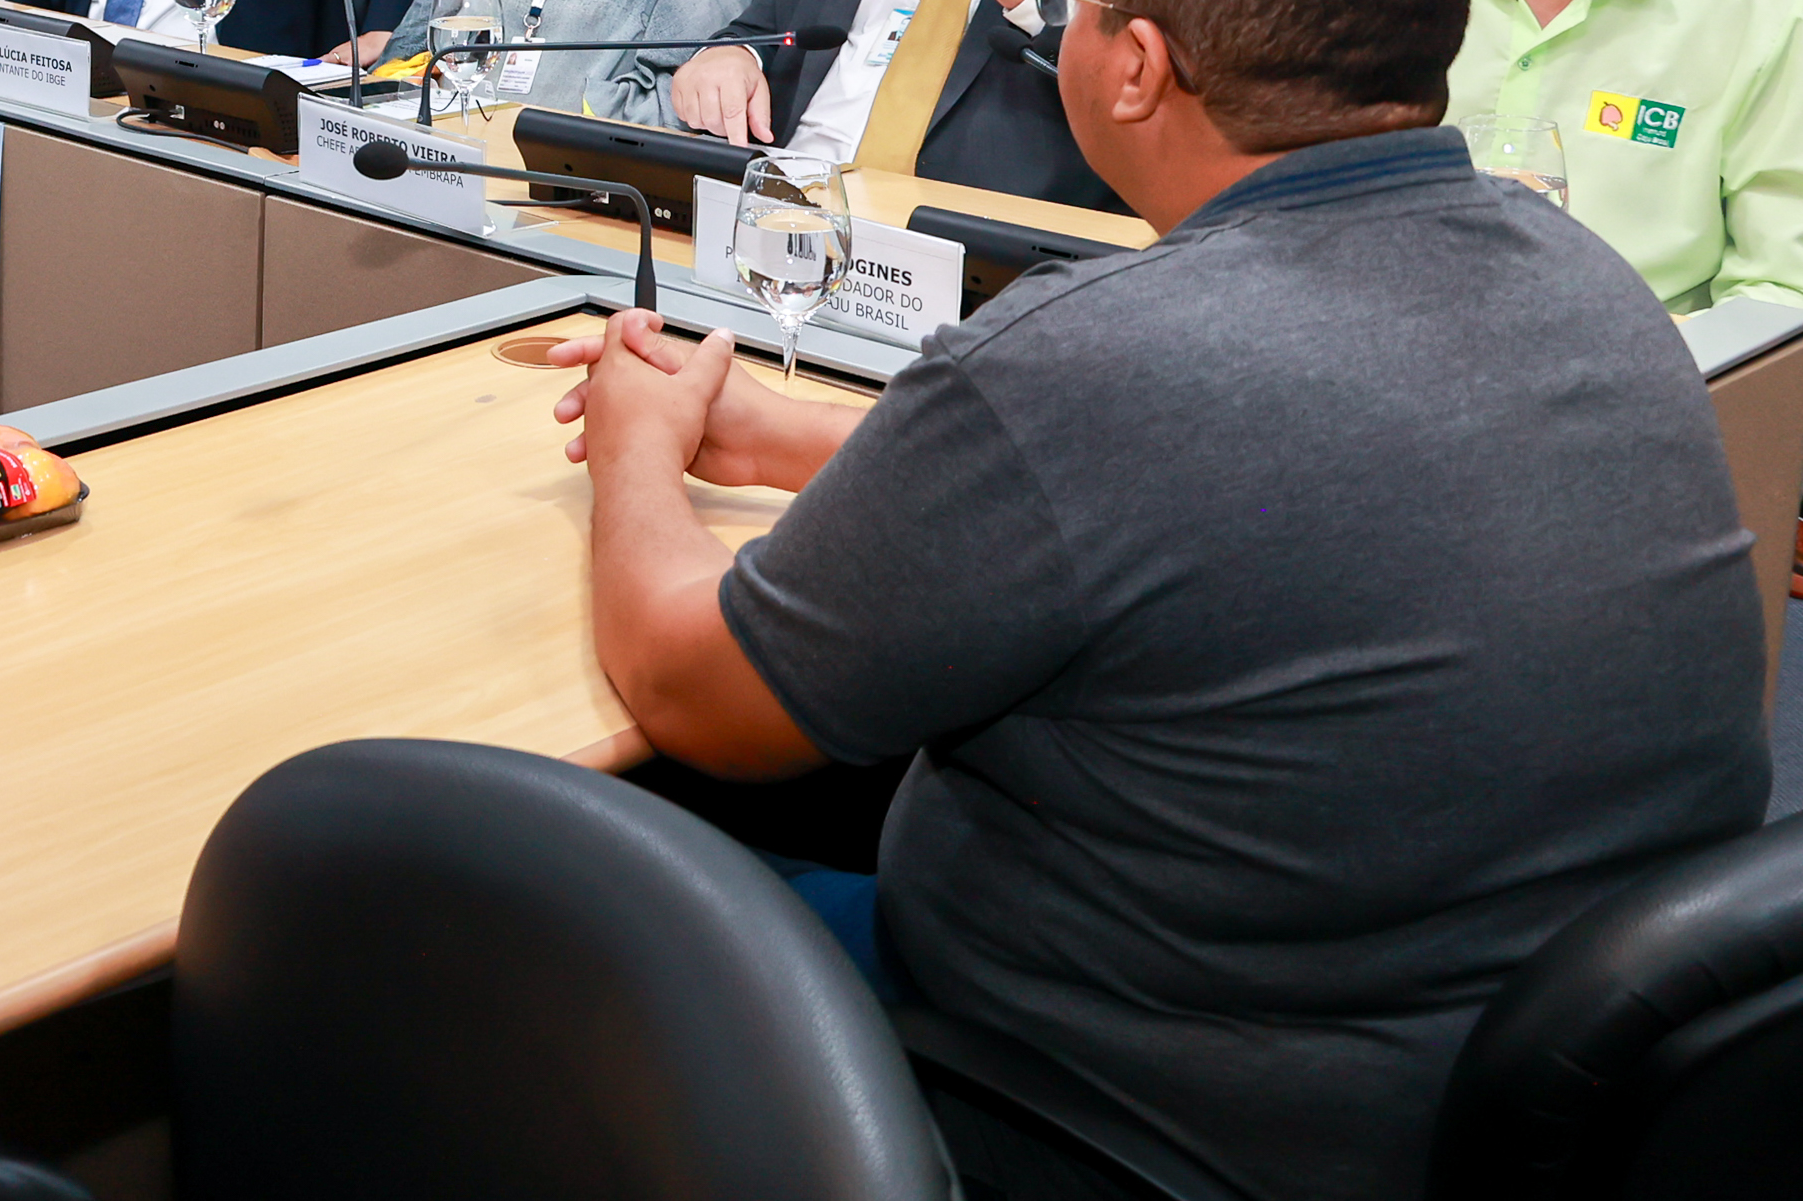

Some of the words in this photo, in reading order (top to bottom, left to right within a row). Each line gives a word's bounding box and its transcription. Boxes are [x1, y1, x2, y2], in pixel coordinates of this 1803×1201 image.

[30, 53, 73, 73] FEITOSA
[31, 69, 44, 82] DO
[46, 72, 66, 87] IBGE
[1637, 105, 1680, 130] ICB
[316, 134, 347, 154] CHEFE
[319, 117, 348, 138] JOSÉ
[411, 143, 458, 164] VIEIRA
[842, 277, 895, 305] DADOR
[900, 297, 924, 312] DO
[824, 295, 850, 313] AJU
[855, 301, 910, 331] BRASIL
